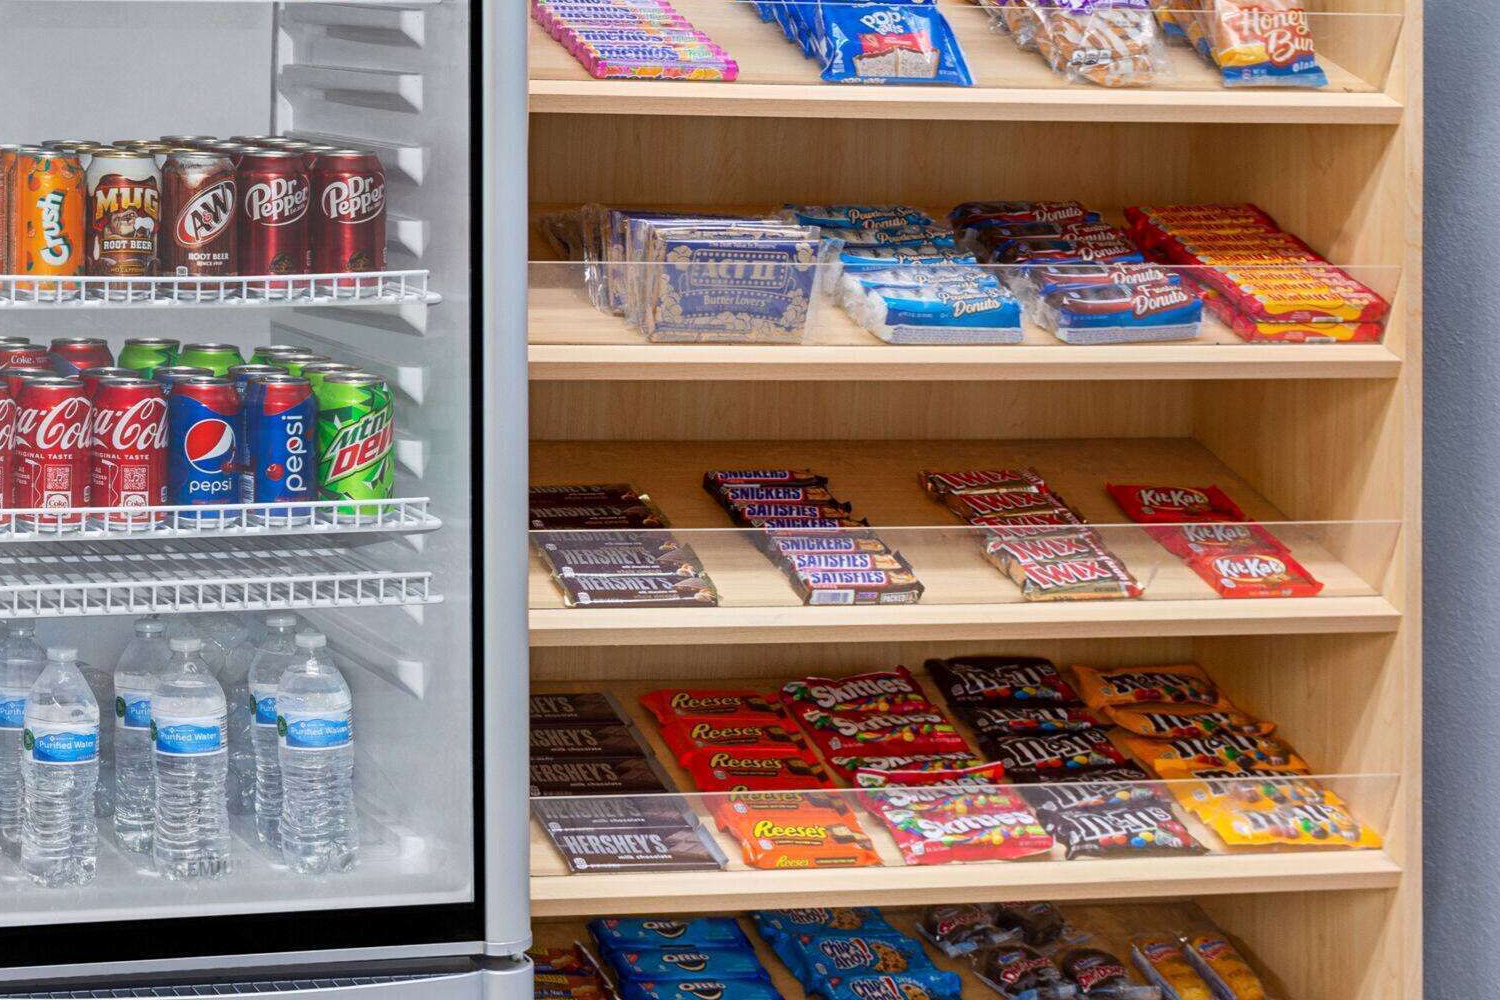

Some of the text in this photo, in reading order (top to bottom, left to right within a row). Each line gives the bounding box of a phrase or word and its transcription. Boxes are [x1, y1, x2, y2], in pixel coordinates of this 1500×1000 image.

[1238, 8, 1309, 35] Honey
[599, 48, 679, 60] mentos
[1265, 29, 1314, 62] Bun
[271, 178, 297, 196] Dr
[348, 176, 373, 194] Dr
[96, 187, 159, 220] MUG
[328, 181, 384, 219] Pepper
[192, 184, 229, 242] A&W
[36, 191, 71, 266] Crush
[103, 241, 153, 250] ROOT BEER
[188, 252, 211, 261] ROOT
[702, 260, 775, 279] ACT II
[704, 295, 767, 307] Butter Lovers
[953, 300, 1001, 318] Donuts
[1133, 292, 1189, 316] Donuts
[282, 415, 308, 492] pepsi
[332, 423, 394, 478] DEW
[189, 478, 232, 495] pepsi
[730, 488, 802, 500] SNICKERS
[780, 539, 853, 550] SNICKERS
[797, 554, 869, 569] SATISFIES
[811, 572, 885, 585] SATISFIES
[1022, 560, 1112, 589] TWIX
[811, 676, 913, 708] Skittles
[39, 741, 72, 750] Purified
[161, 732, 217, 742] Purified Water
[753, 820, 827, 838] Reese's
[1065, 807, 1172, 841] m&m's
[563, 835, 668, 854] HERSHEY'S
[820, 939, 857, 958] Chips
[662, 953, 709, 963] OREO
[678, 982, 726, 991] OREO
